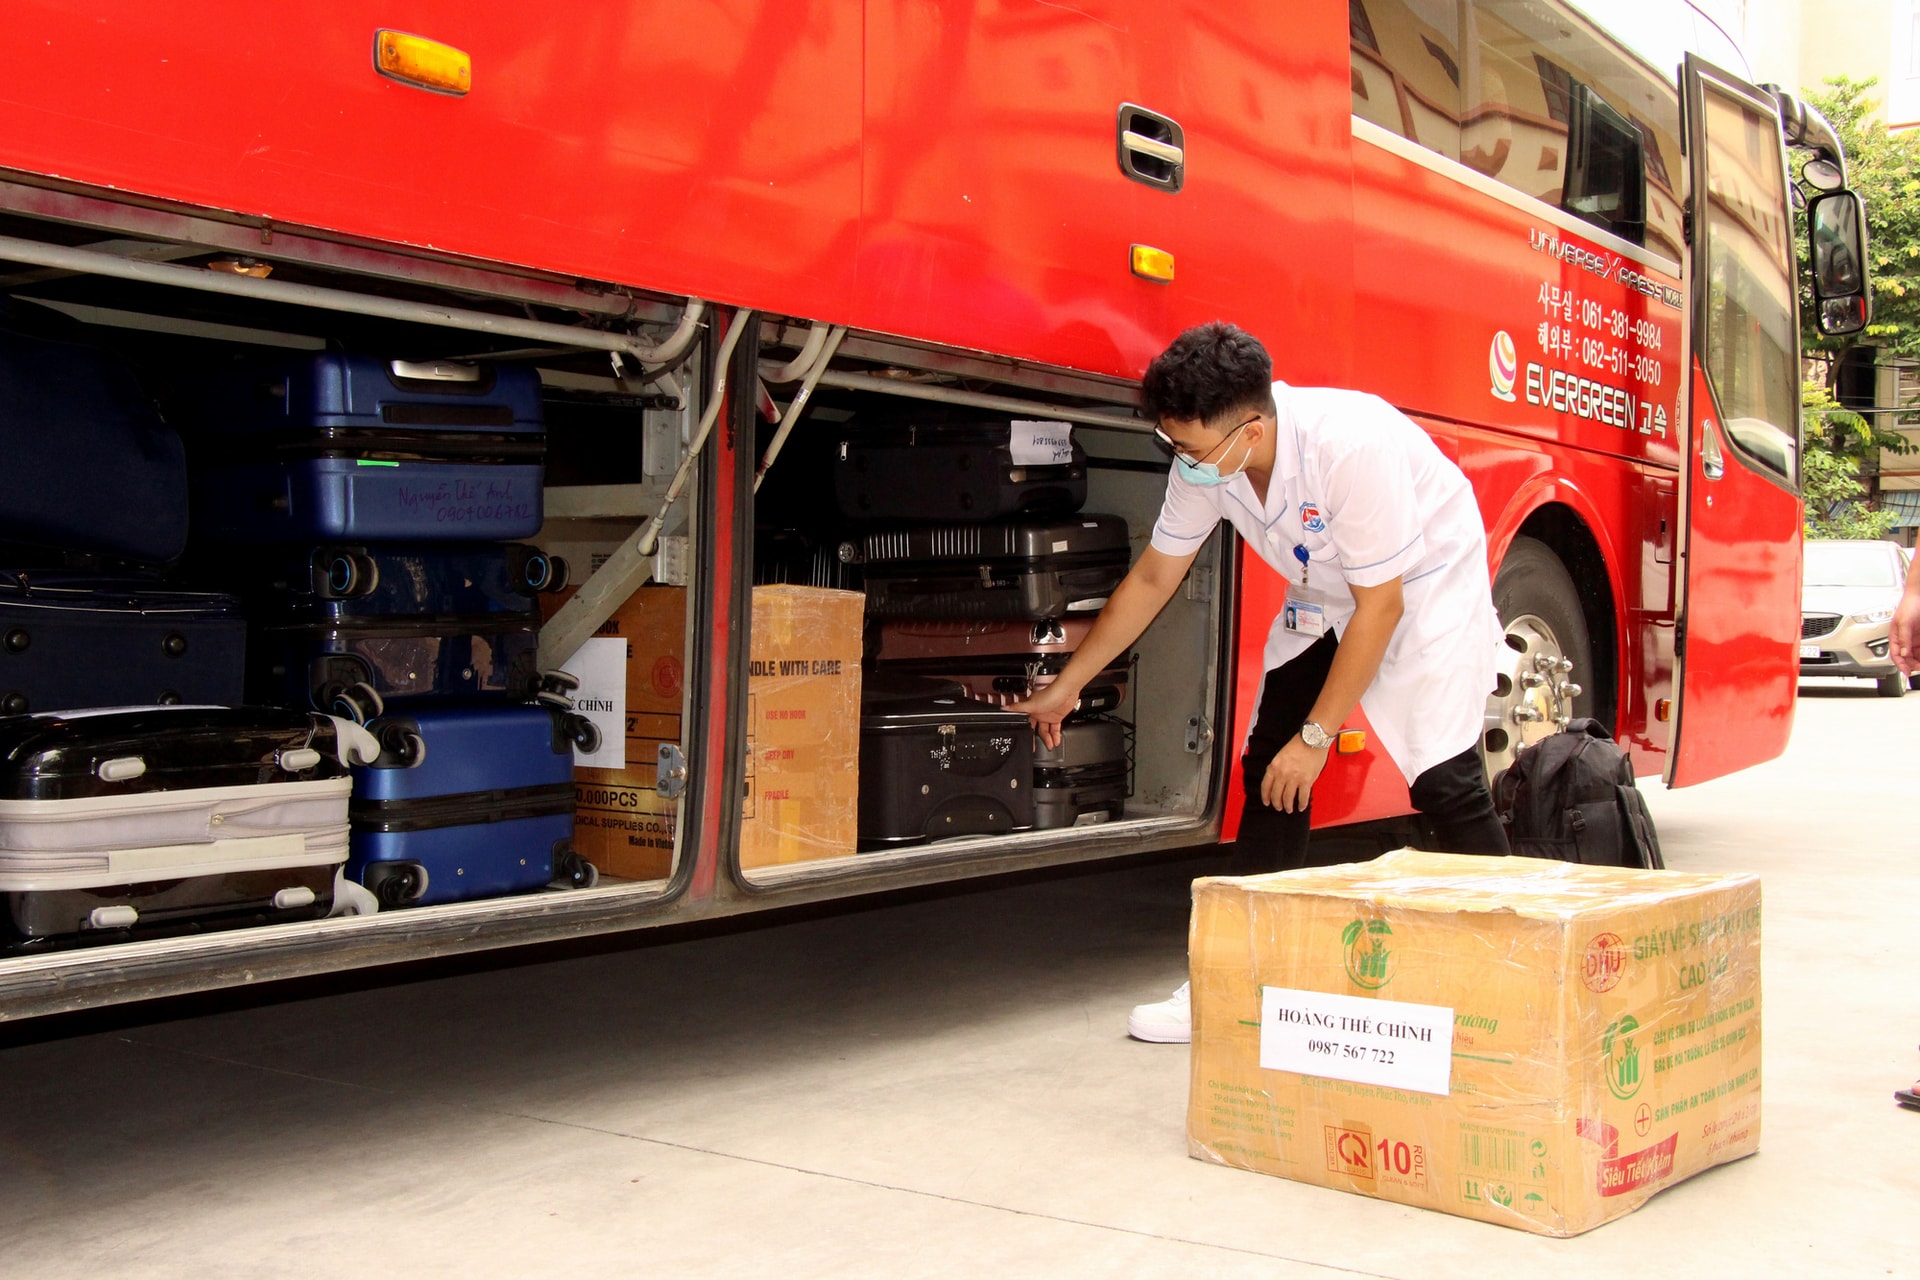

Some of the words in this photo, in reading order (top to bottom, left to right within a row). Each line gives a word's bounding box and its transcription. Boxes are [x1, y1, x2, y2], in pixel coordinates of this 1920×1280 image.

[1582, 298, 1662, 351] 061-381-9984
[1582, 337, 1661, 386] 062-511-3050
[1526, 362, 1636, 430] EVERGREEN
[1639, 401, 1667, 439] 고속
[779, 660, 808, 677] WITH
[812, 660, 841, 676] CARE
[765, 711, 778, 720] USE
[779, 711, 789, 720] NO
[789, 710, 806, 720] HOOK
[602, 817, 644, 832] SUPPLIES
[628, 836, 646, 847] Made
[1679, 961, 1706, 990] CAO
[1279, 1008, 1335, 1029] HOÀNG
[1308, 1039, 1339, 1056] 0987
[1343, 1044, 1367, 1061] 567
[1371, 1049, 1395, 1065] 722
[1377, 1139, 1411, 1175] 10
[1413, 1145, 1424, 1179] ROLL
[1602, 1166, 1625, 1188] Siêu
